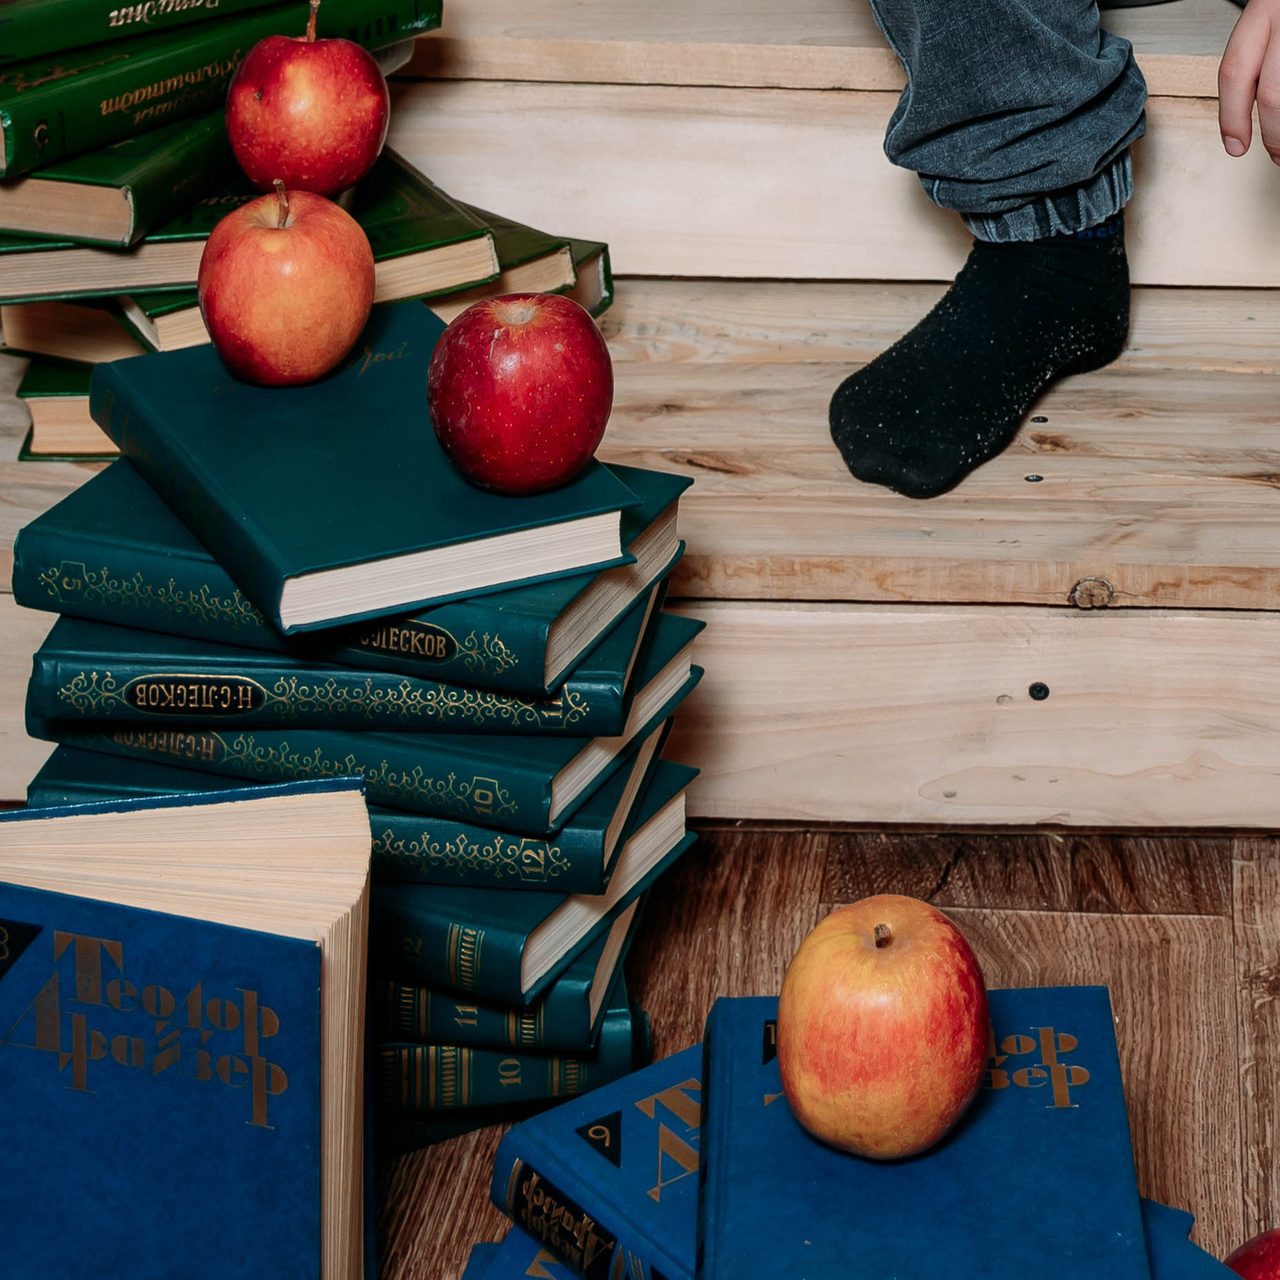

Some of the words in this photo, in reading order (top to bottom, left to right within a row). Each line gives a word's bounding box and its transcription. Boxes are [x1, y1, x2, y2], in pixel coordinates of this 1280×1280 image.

[100, 48, 241, 117] удольштадт
[473, 788, 494, 815] 10
[521, 848, 545, 874] 12
[454, 1004, 478, 1028] 11
[497, 1058, 522, 1089] 10
